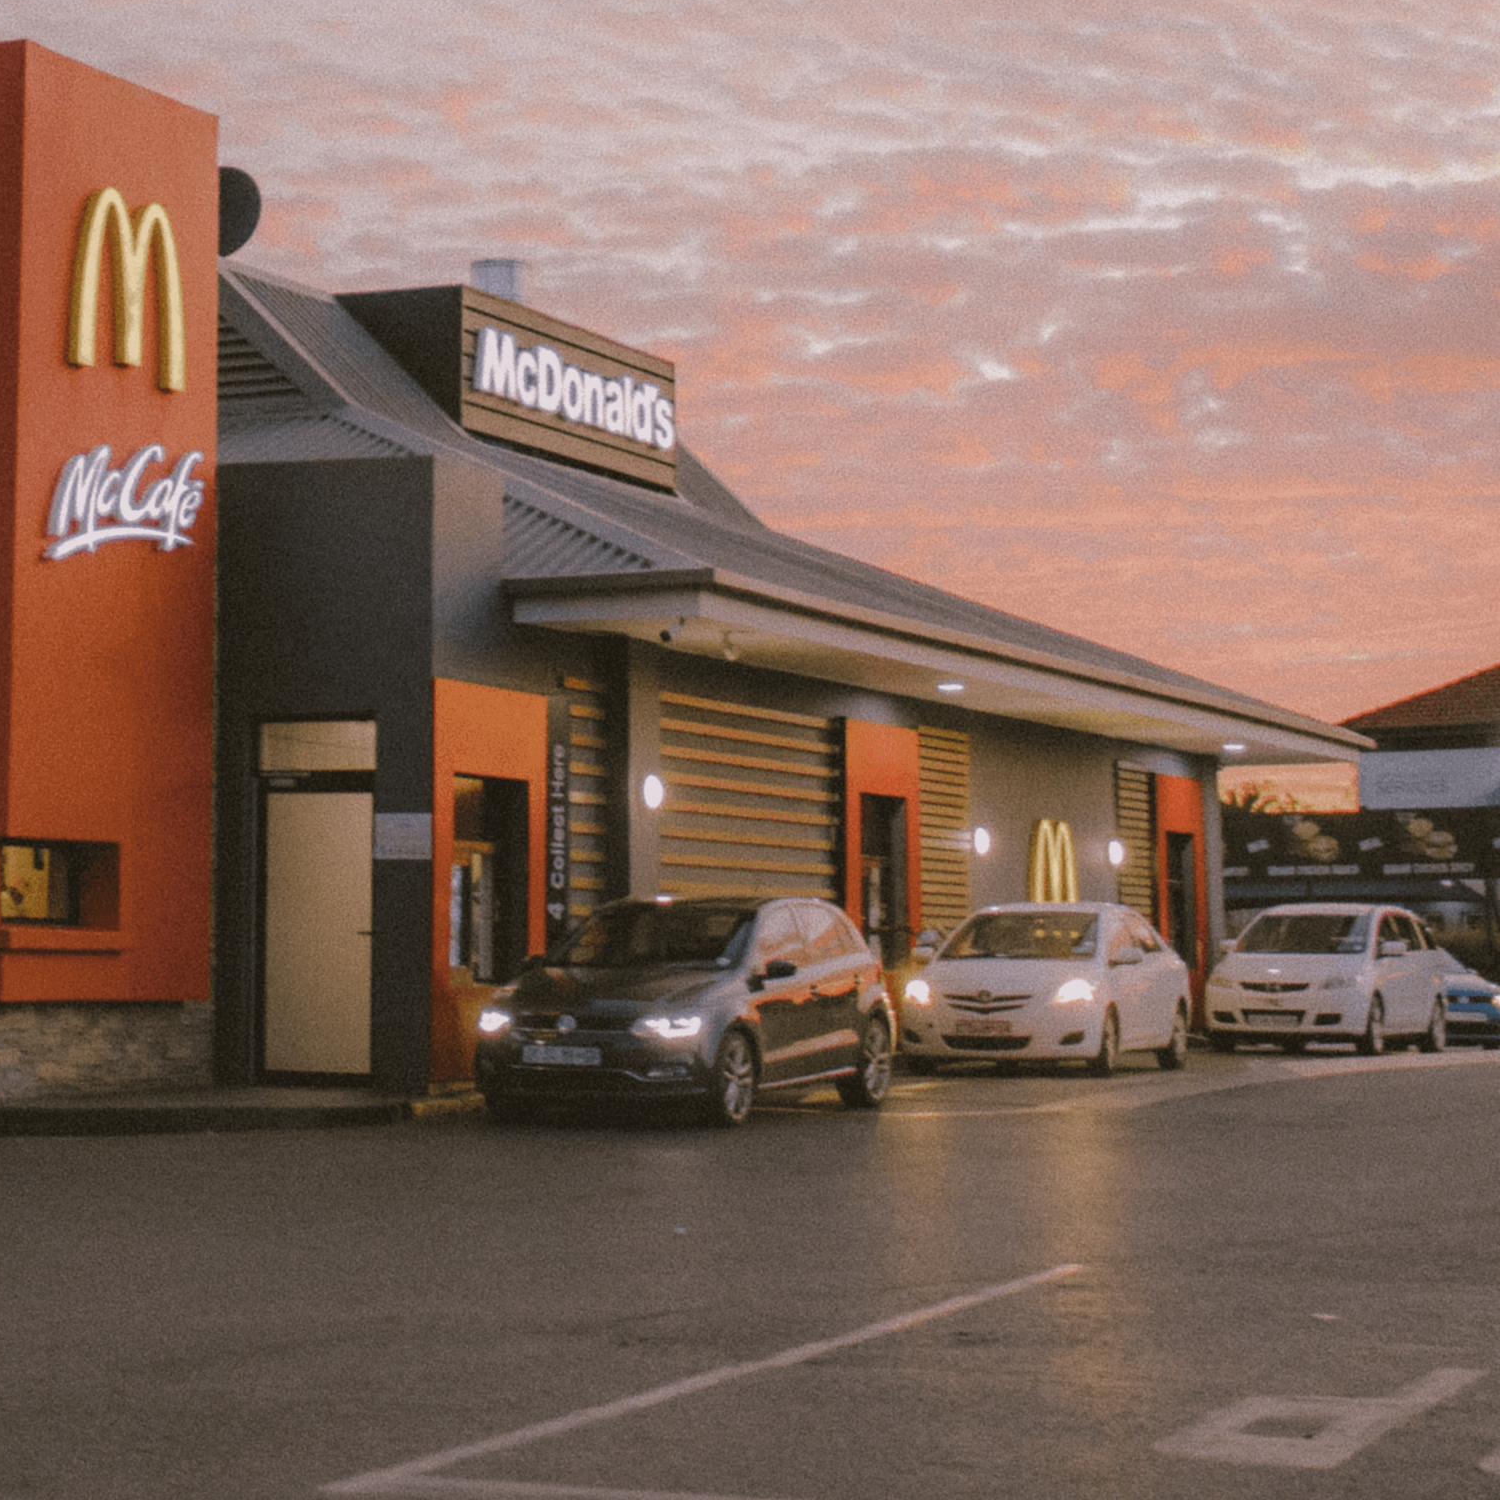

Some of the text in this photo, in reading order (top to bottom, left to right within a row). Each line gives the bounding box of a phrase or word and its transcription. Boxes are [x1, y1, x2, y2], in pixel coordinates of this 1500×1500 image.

[473, 326, 676, 450] McDonald's
[47, 443, 205, 556] McCafé
[550, 744, 566, 798] Here
[550, 804, 565, 889] Collect
